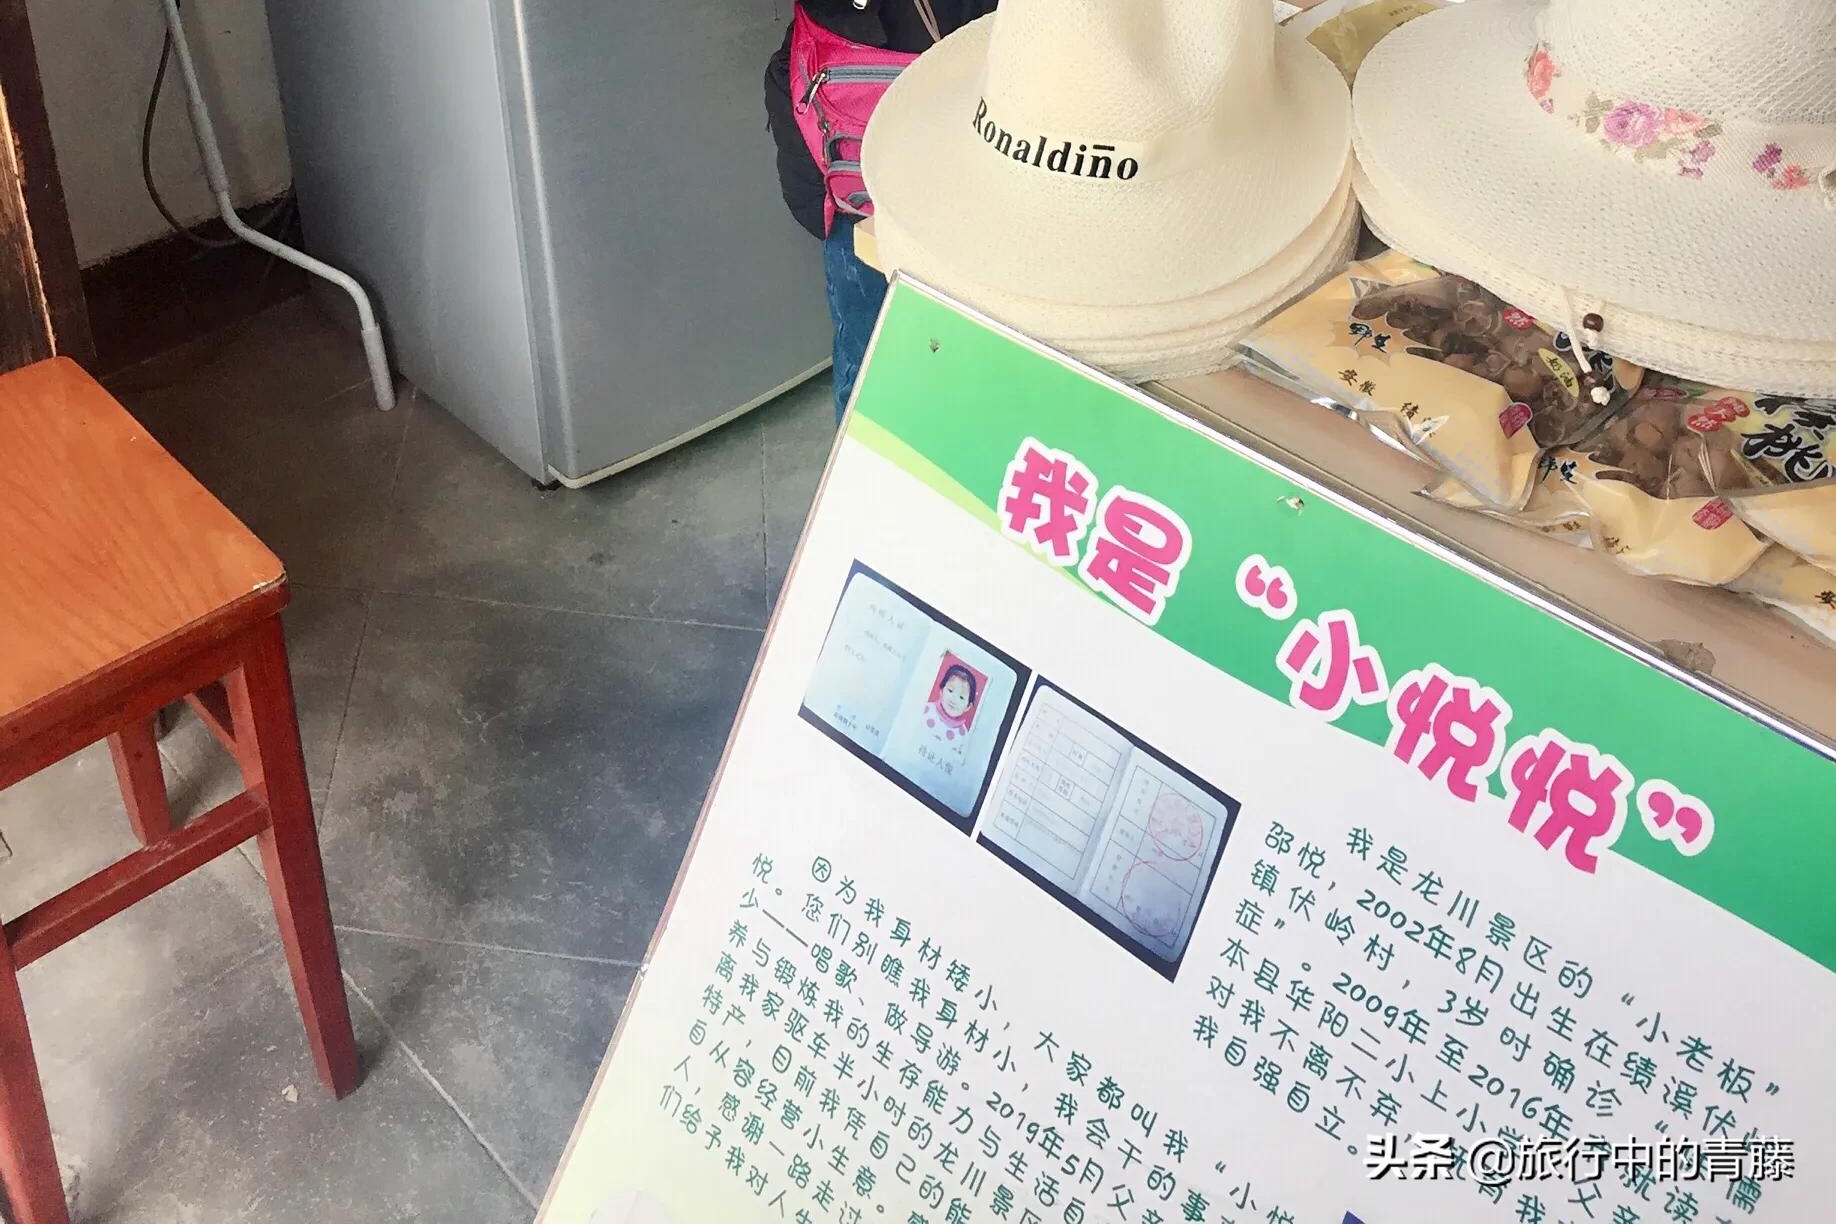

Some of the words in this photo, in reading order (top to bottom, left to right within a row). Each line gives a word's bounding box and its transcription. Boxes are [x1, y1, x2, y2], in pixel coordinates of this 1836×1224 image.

[752, 852, 1234, 1224] 悦。您们别瞧我身材小，我会干的事
[1193, 1014, 1358, 1156] 我自强自立。
